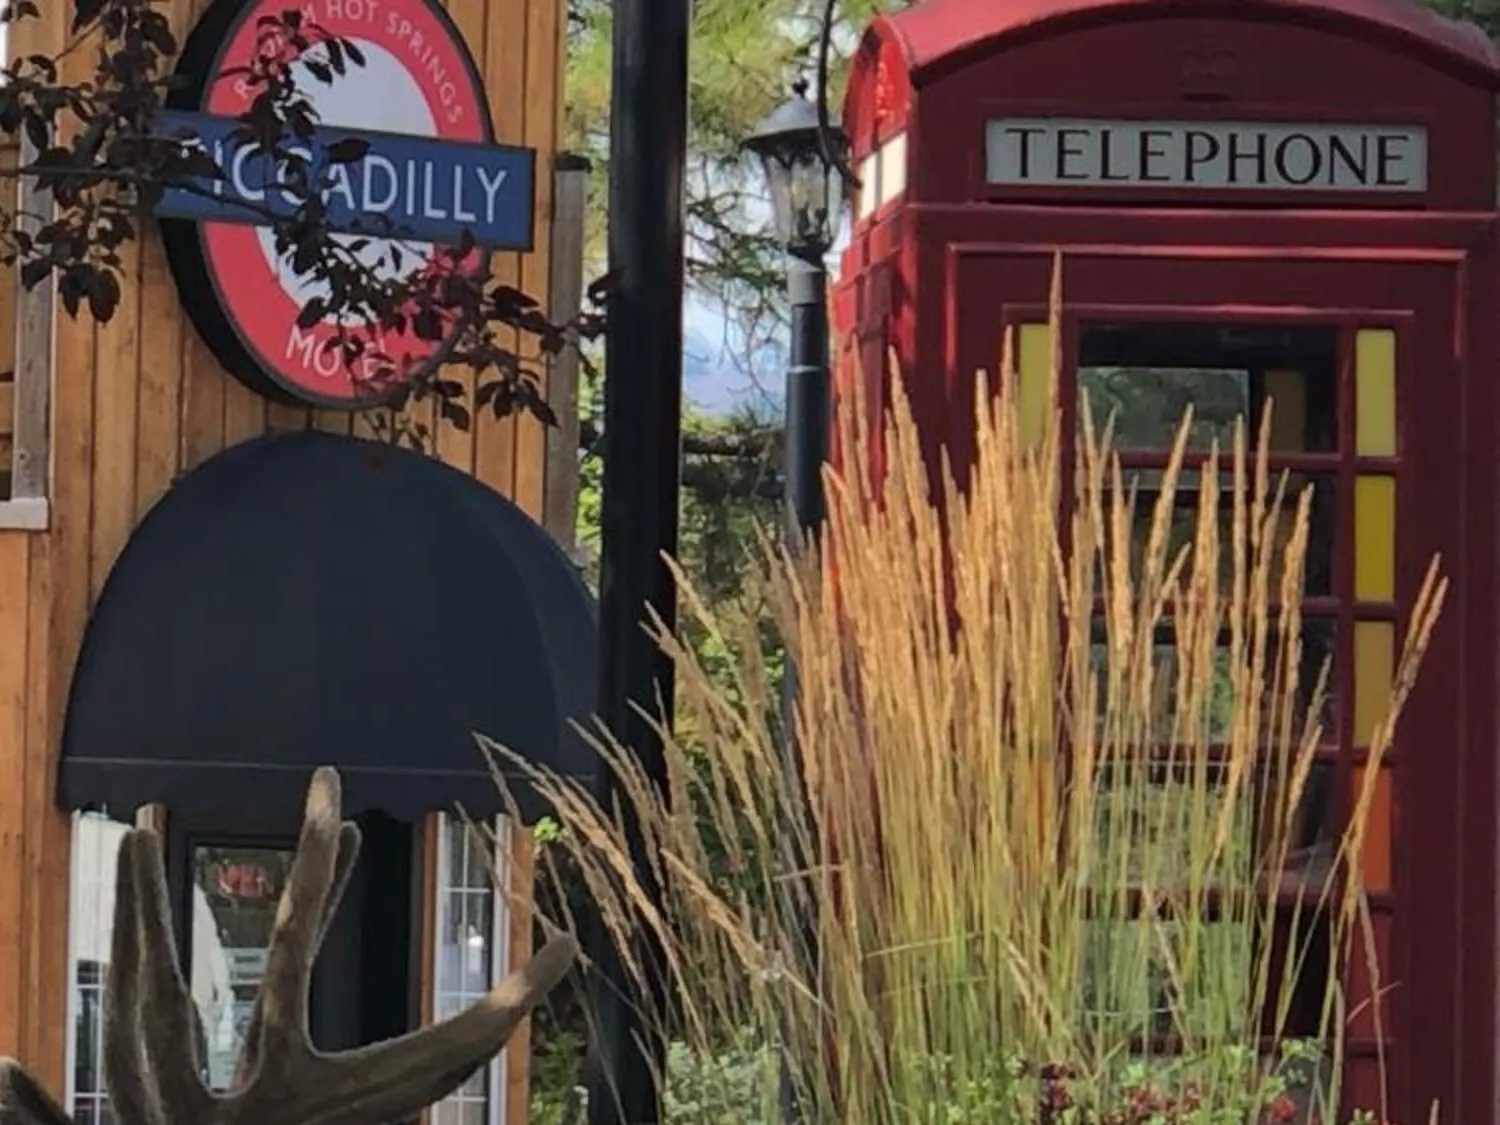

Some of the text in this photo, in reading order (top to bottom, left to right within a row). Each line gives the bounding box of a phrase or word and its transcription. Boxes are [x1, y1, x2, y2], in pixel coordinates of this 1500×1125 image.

[325, 0, 380, 23] HOT
[386, 10, 463, 123] SPRINGS
[180, 138, 507, 223] ICCADILLY
[1005, 127, 1410, 186] TELEPHONE
